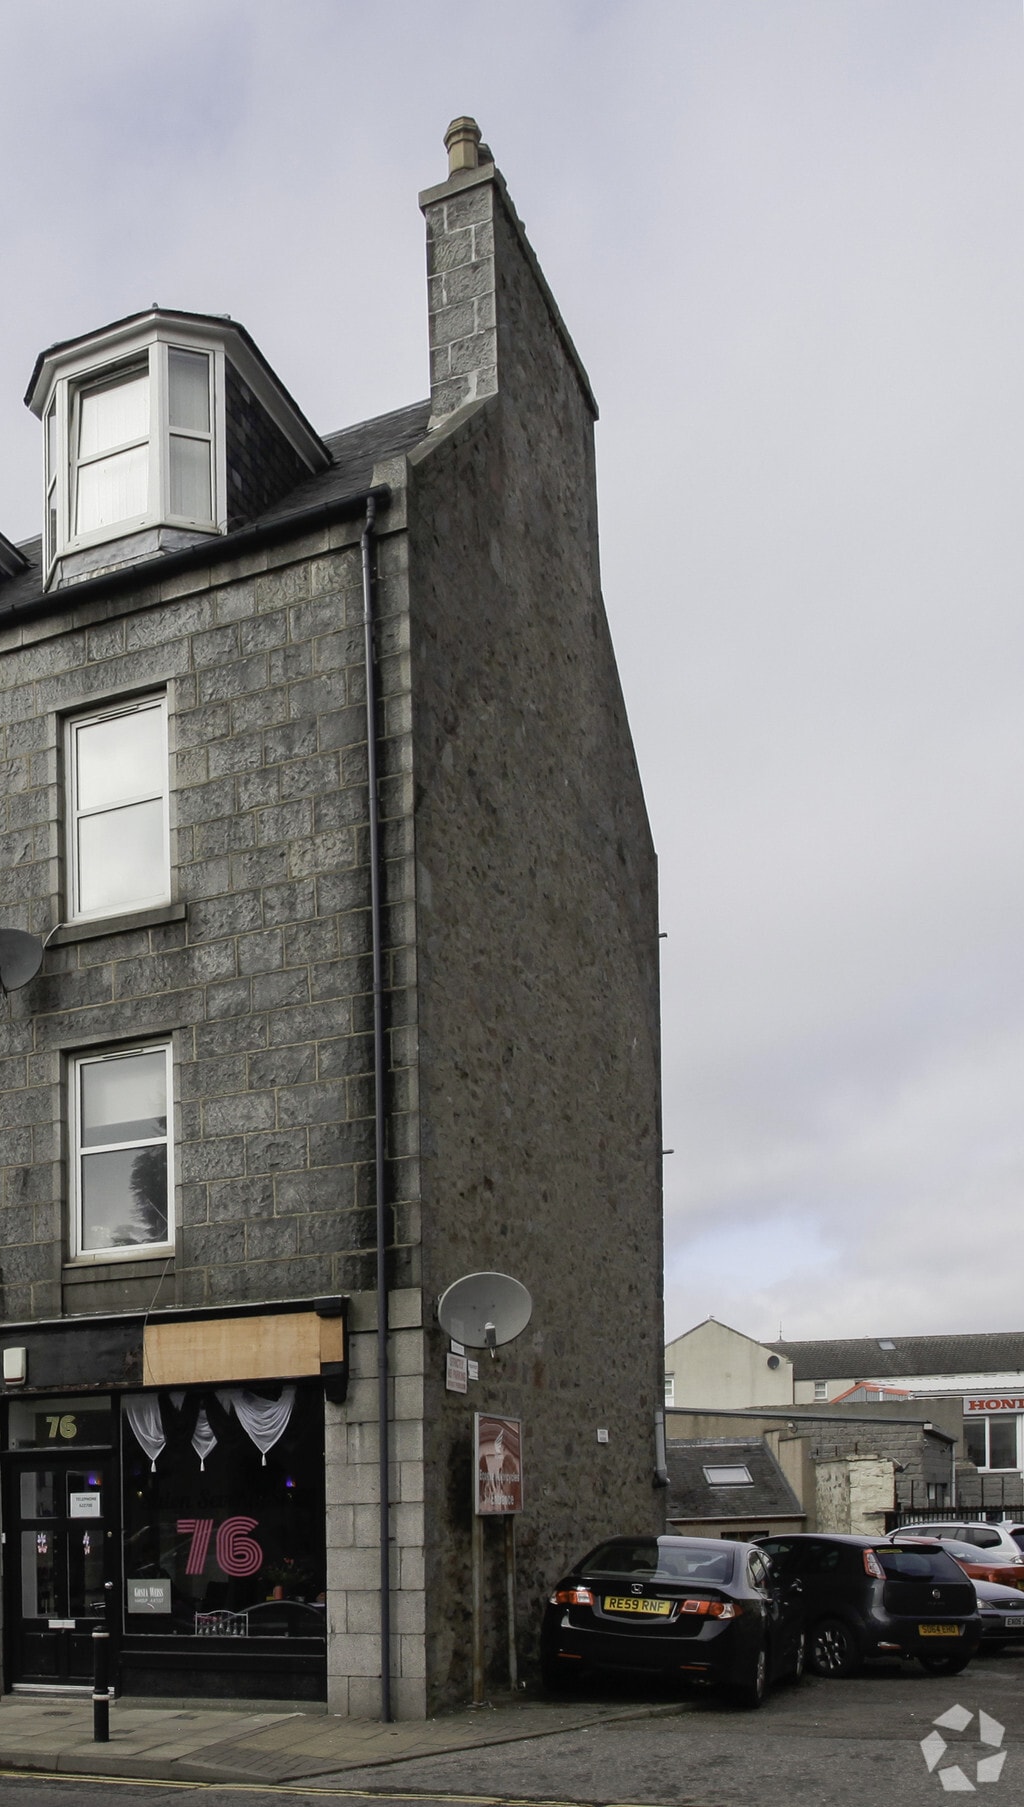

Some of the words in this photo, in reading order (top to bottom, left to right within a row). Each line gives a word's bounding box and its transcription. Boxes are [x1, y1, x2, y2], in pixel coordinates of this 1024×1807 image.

[46, 1415, 77, 1439] 76
[177, 1515, 263, 1577] 76
[609, 1597, 639, 1610] RE59
[641, 1600, 665, 1612] RNF
